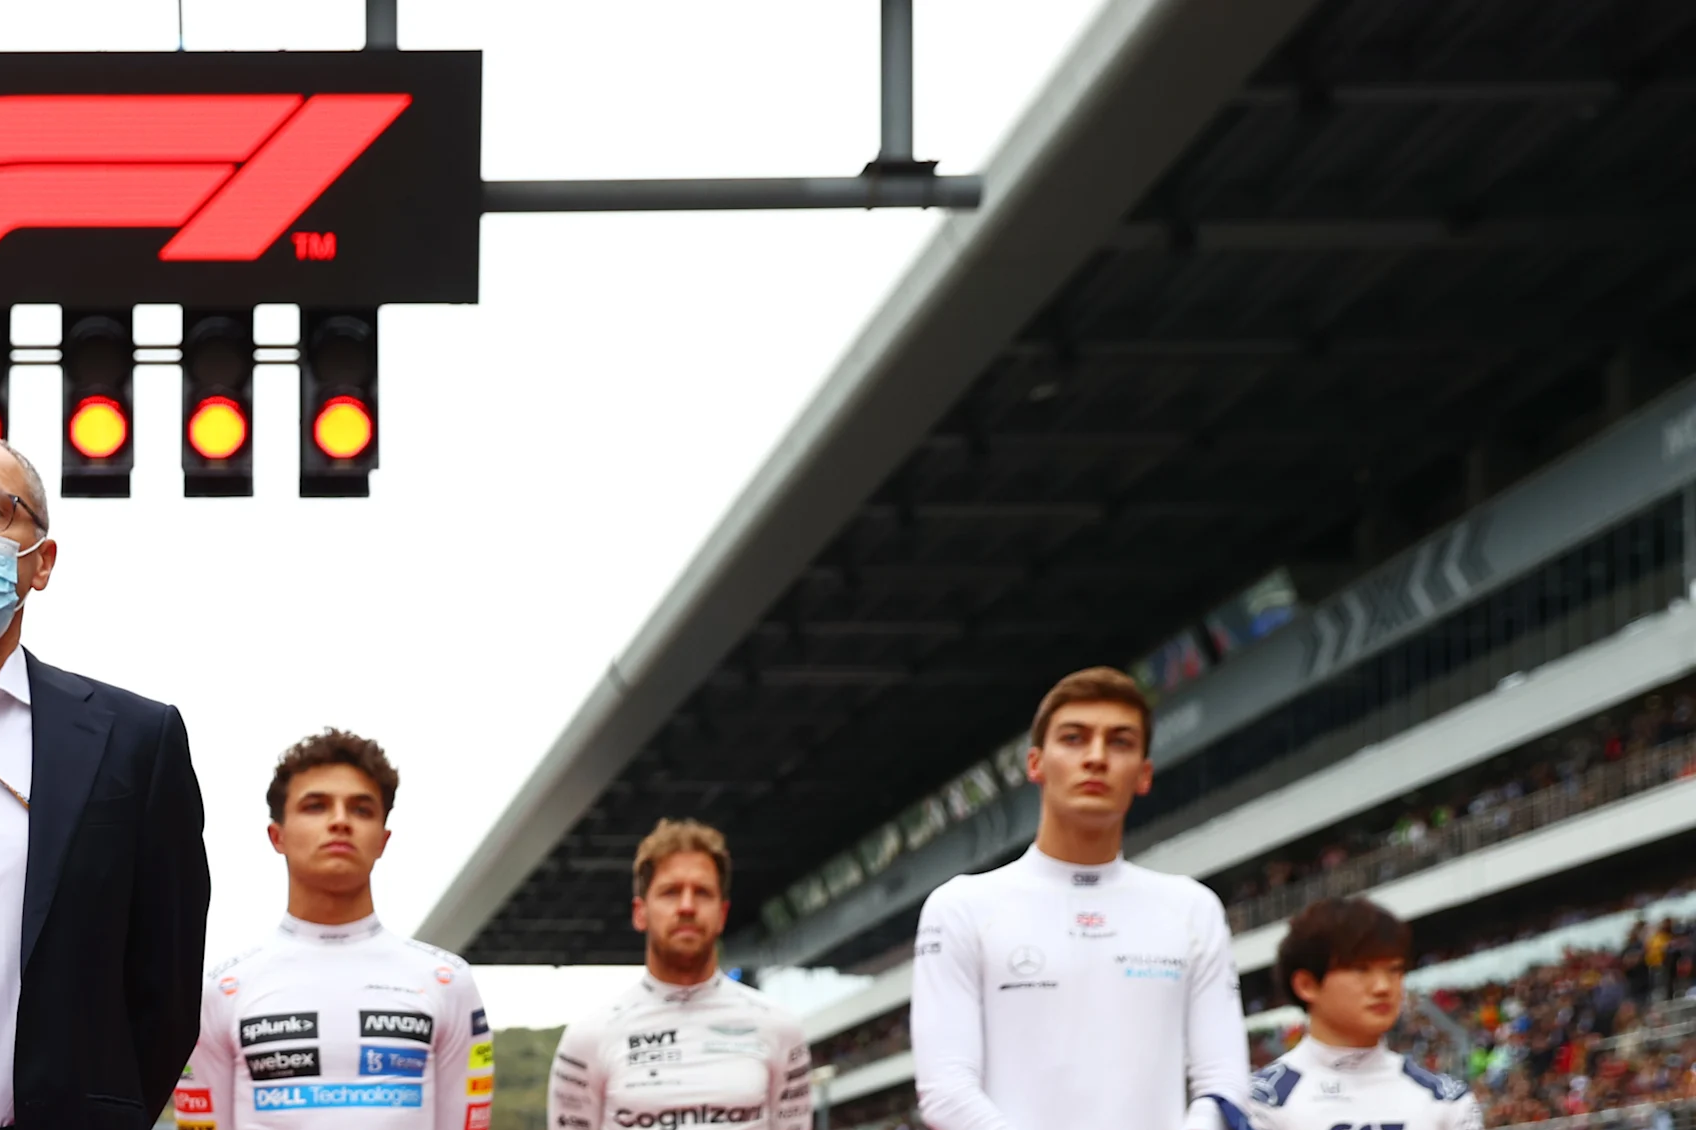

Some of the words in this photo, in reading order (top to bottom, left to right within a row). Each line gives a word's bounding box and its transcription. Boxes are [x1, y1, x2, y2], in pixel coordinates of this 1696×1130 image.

[292, 233, 338, 261] TM
[627, 1029, 679, 1049] BWT
[249, 1051, 314, 1072] webex
[256, 1087, 307, 1106] DELL
